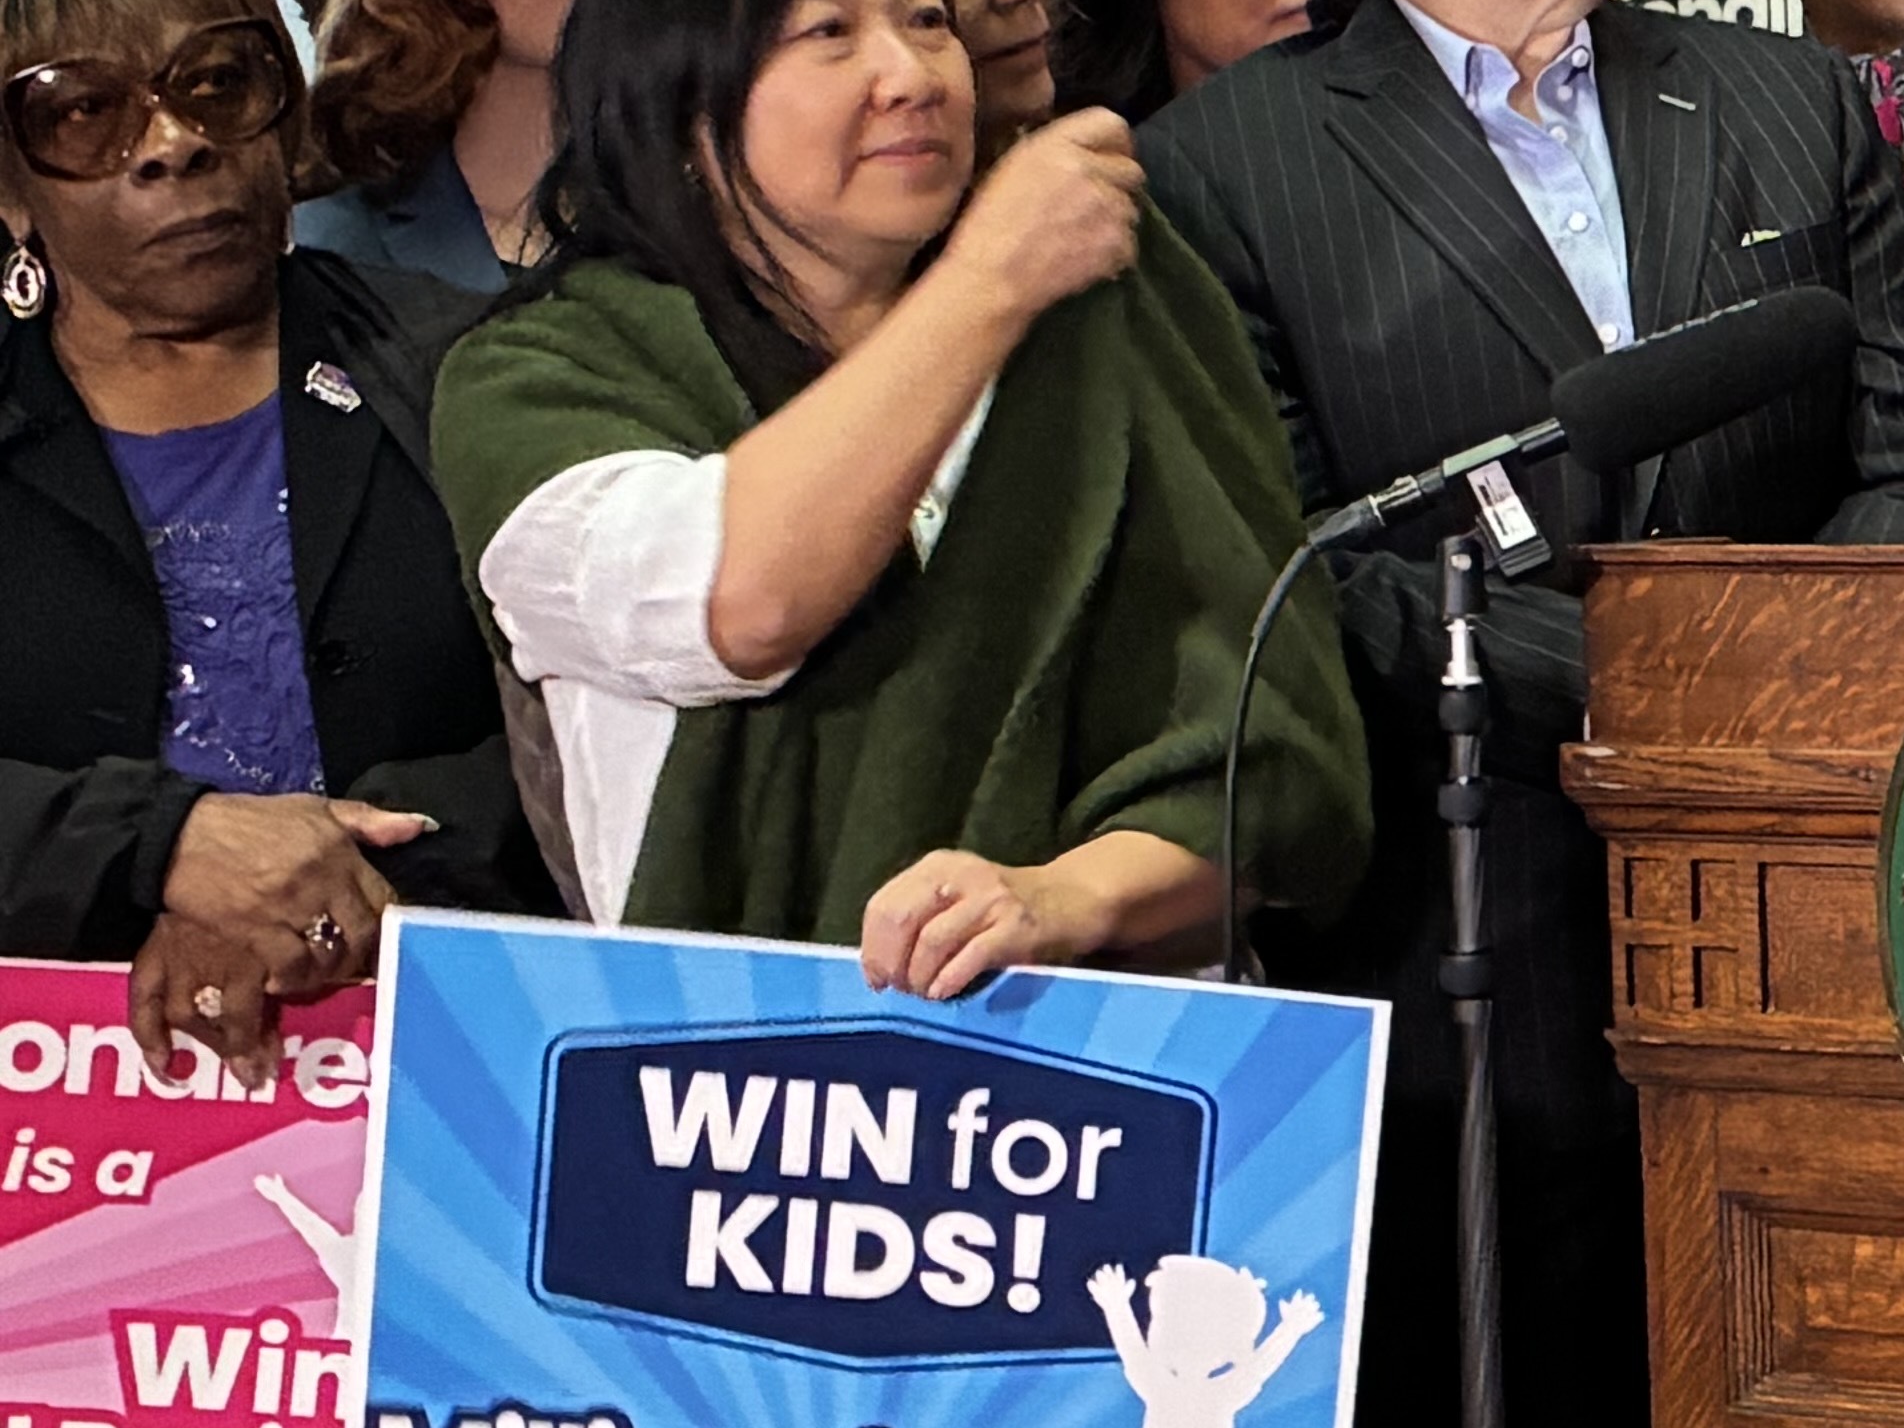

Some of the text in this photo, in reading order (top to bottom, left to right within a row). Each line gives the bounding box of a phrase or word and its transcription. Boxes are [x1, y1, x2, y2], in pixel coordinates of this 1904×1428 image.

[1, 1127, 154, 1197] is a
[639, 1065, 1123, 1201] WIN for
[686, 1189, 1047, 1314] KIDS!
